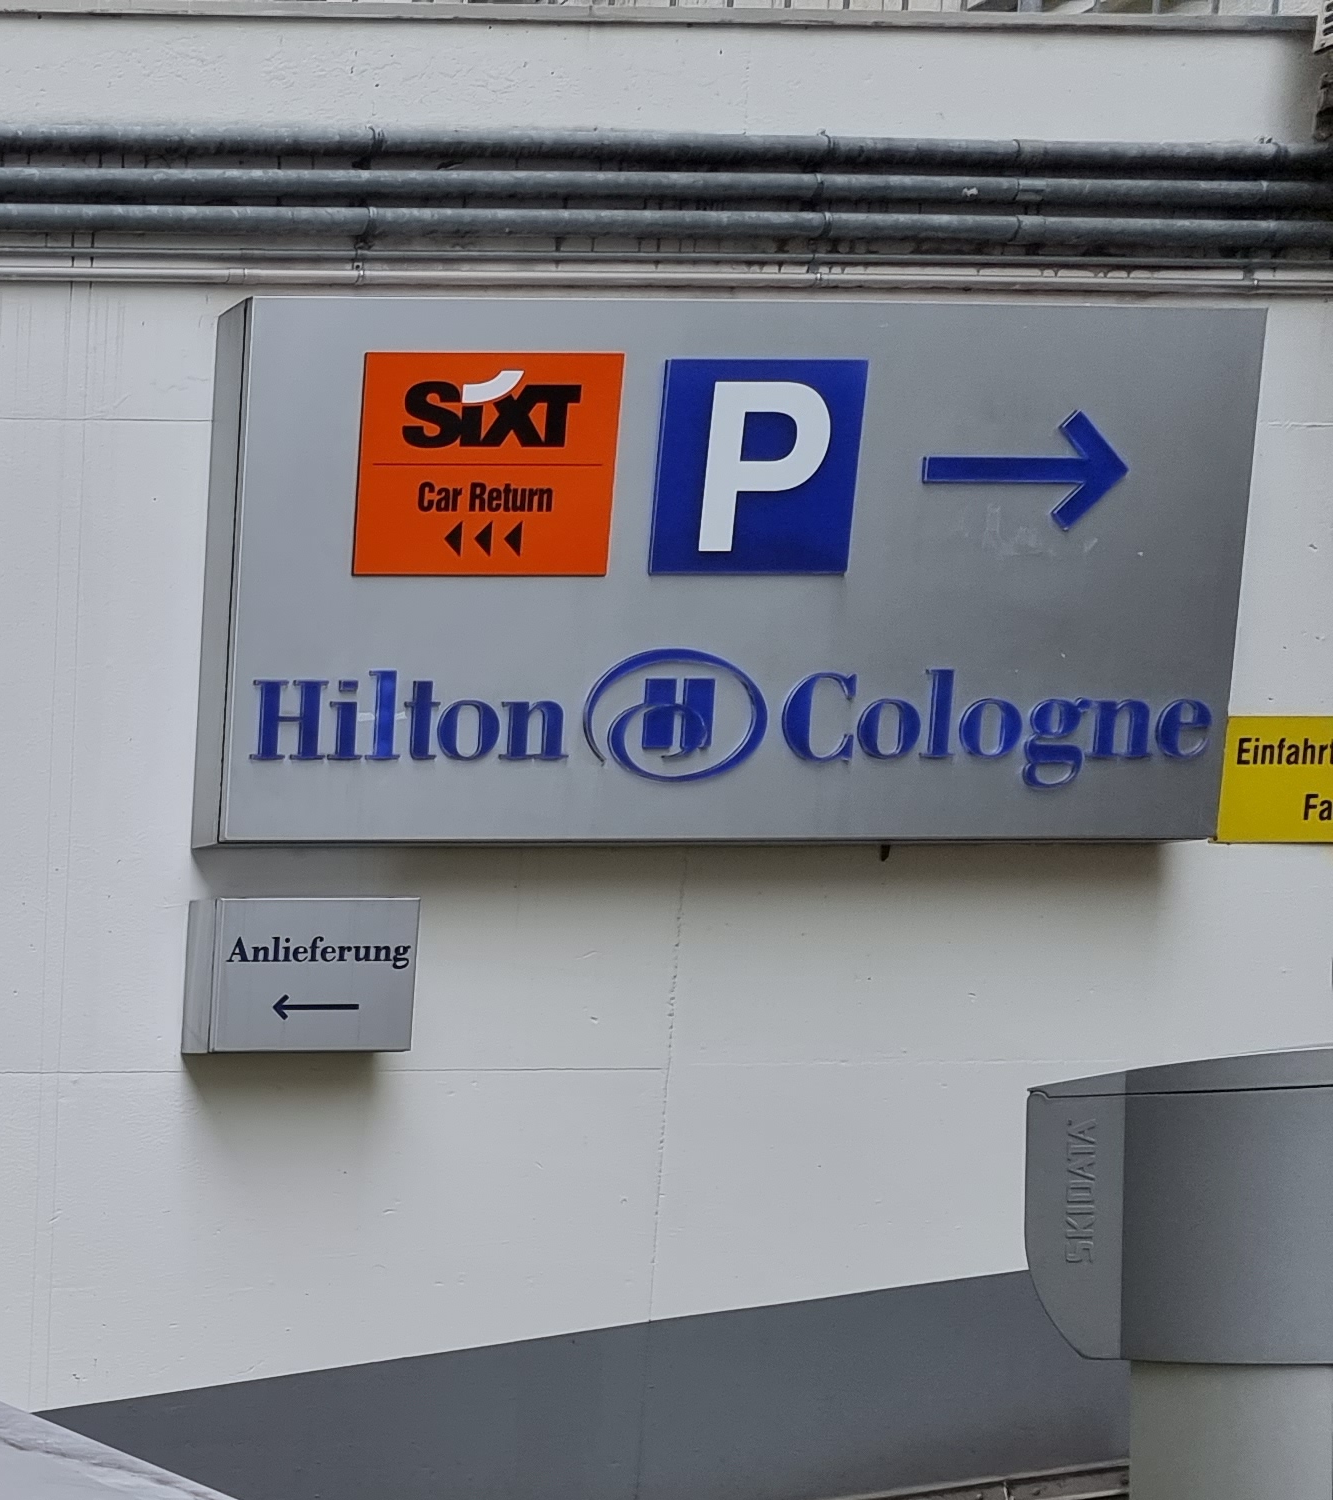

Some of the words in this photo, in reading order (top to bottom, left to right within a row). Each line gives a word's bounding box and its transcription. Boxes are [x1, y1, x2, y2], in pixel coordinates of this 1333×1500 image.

[417, 481, 462, 513] Car
[469, 481, 554, 513] Return
[698, 380, 831, 552] P
[249, 668, 569, 762] Hilton
[780, 668, 1213, 789] Cologne
[226, 936, 412, 970] Anlieferung
[1065, 1118, 1097, 1264] SKIDATA
